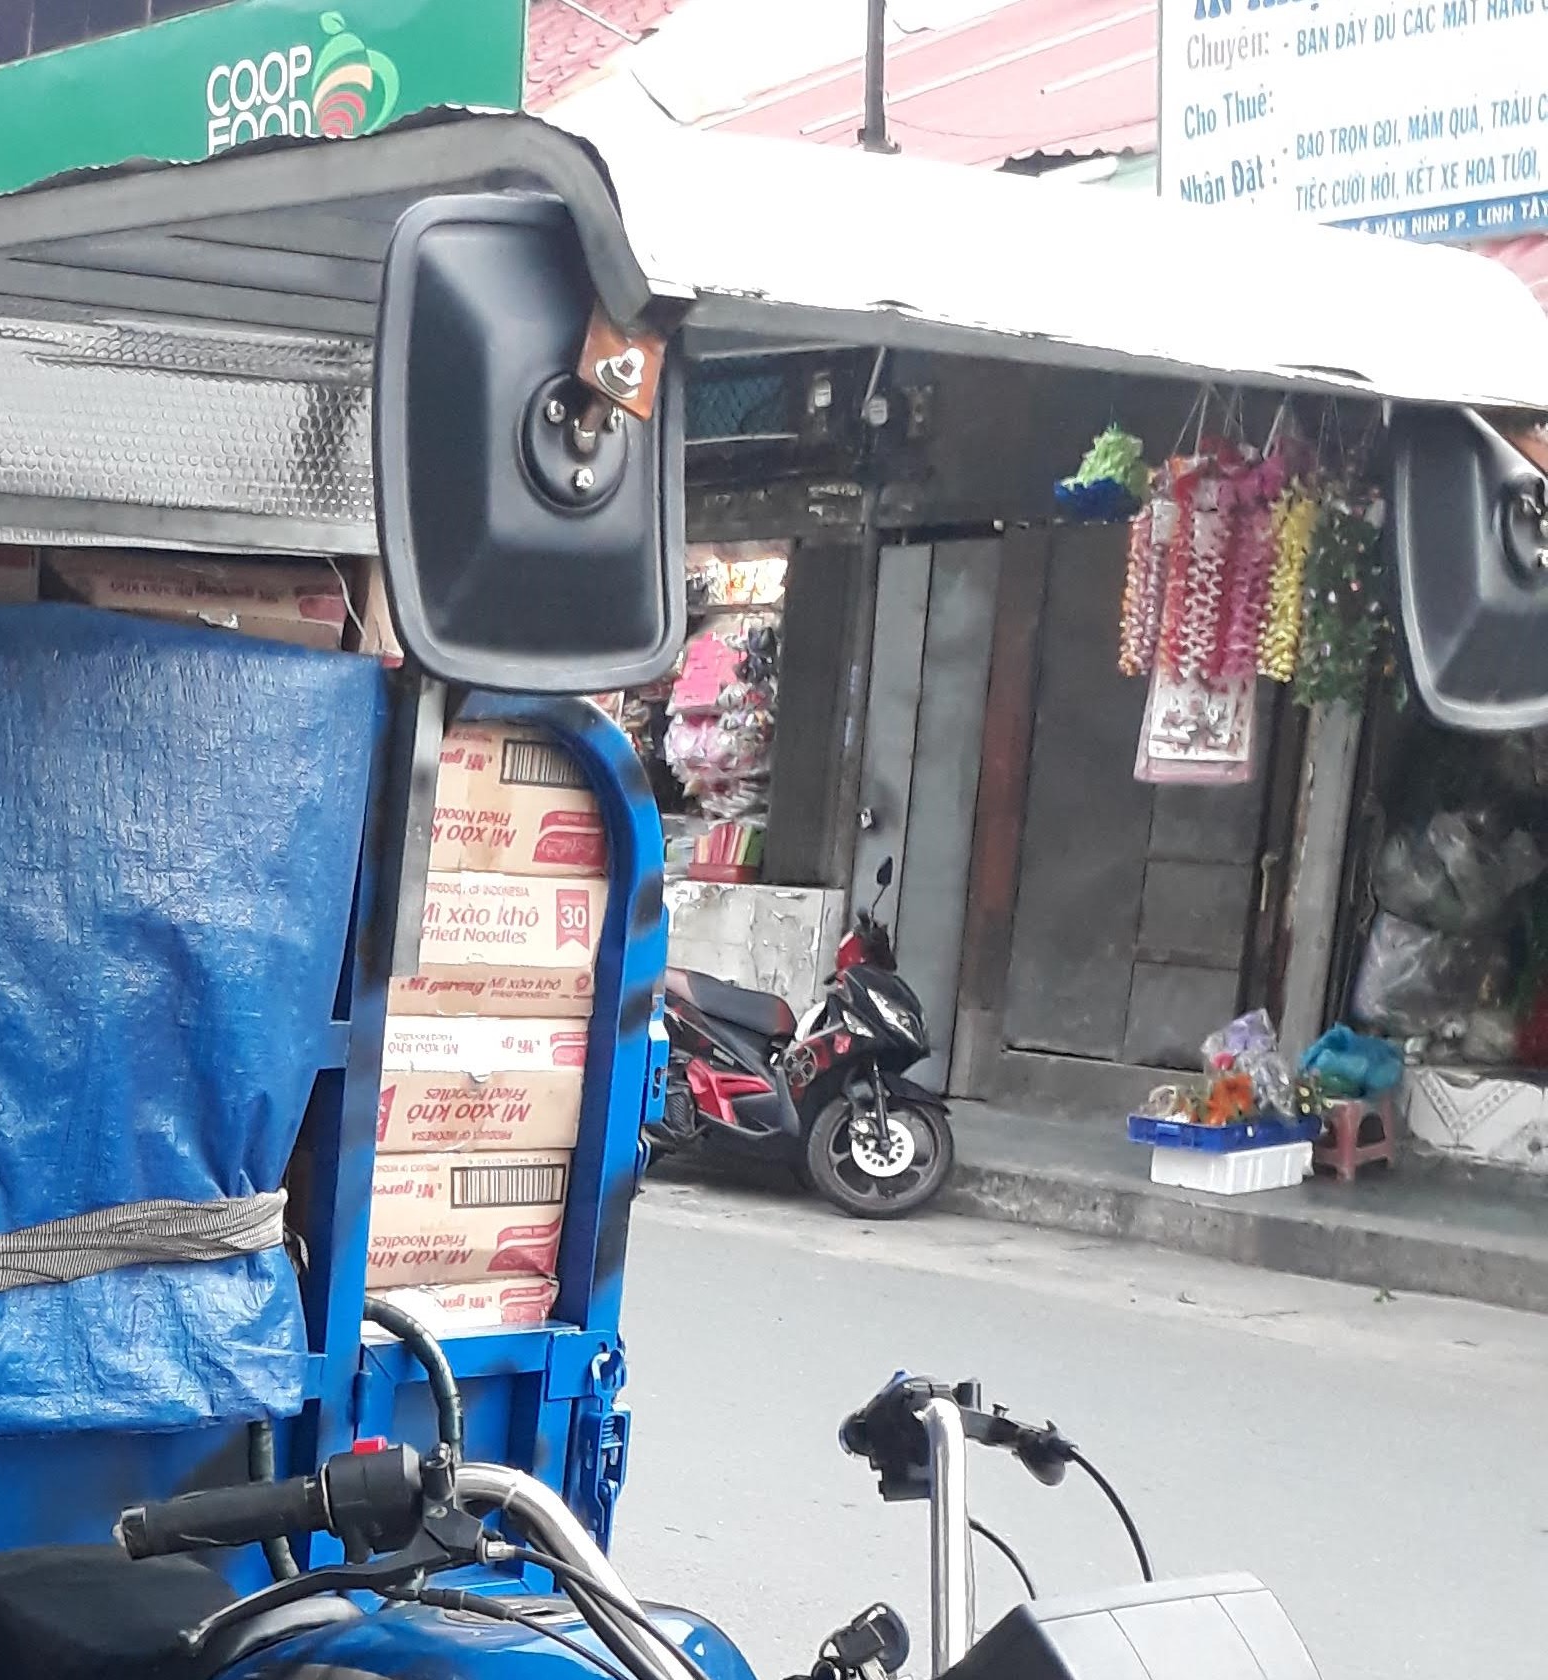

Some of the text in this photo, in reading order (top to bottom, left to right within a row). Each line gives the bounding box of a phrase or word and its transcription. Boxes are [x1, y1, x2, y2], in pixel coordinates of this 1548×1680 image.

[1184, 104, 1218, 140] Cho
[1296, 130, 1325, 160] BAO
[1440, 161, 1460, 190] XE
[1465, 156, 1496, 188] HOA
[1411, 212, 1450, 236] NINH
[1476, 202, 1515, 227] LINH
[477, 810, 512, 827] Fried
[445, 824, 489, 848] xào
[447, 903, 491, 926] xào
[497, 900, 540, 928] khô
[559, 903, 588, 930] 30
[420, 925, 528, 945] Fried Noodles
[427, 979, 487, 996] goreng
[406, 1102, 533, 1124] Mì xào khô
[371, 1234, 468, 1249] Fried Noodles
